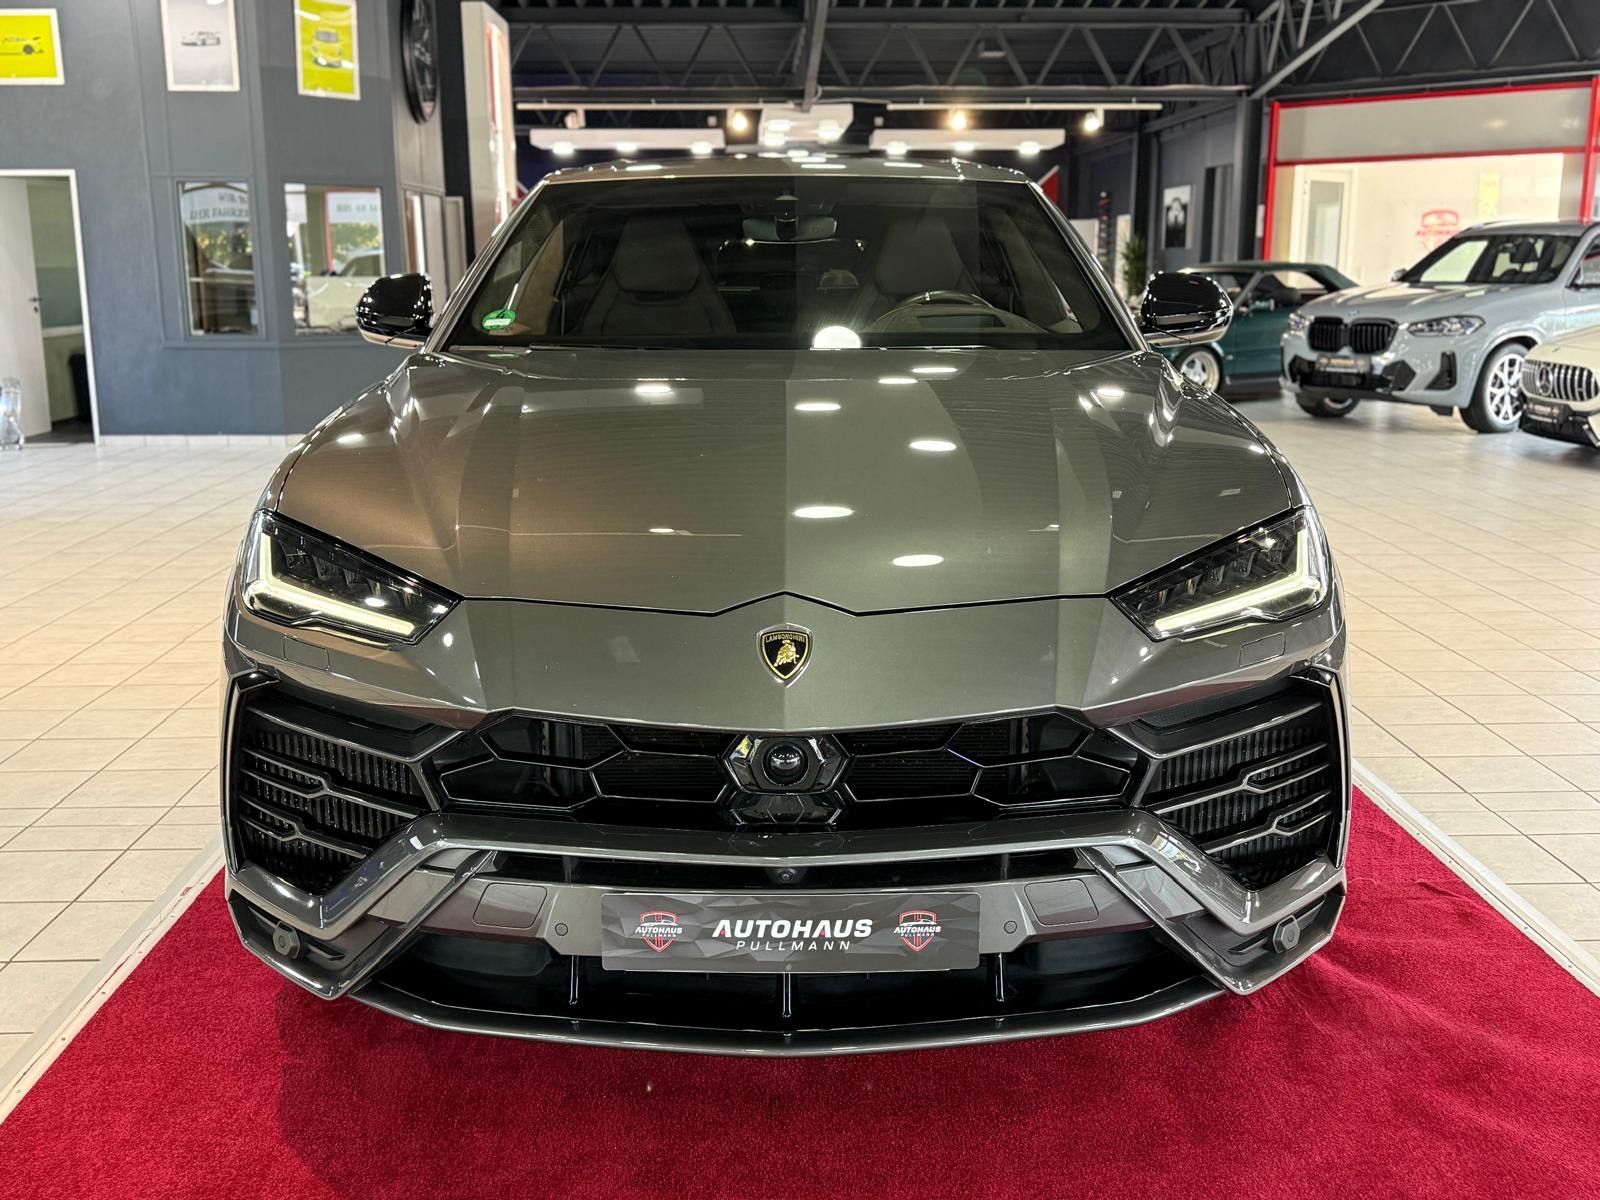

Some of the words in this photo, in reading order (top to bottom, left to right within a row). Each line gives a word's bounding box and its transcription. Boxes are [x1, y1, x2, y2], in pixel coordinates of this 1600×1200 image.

[766, 633, 806, 643] LAMBORGHINI
[634, 926, 684, 934] AUTOHAUS
[711, 918, 873, 938] AUTOHAUS
[893, 925, 942, 934] AUTOHAUS
[736, 940, 851, 951] PULLMANN
